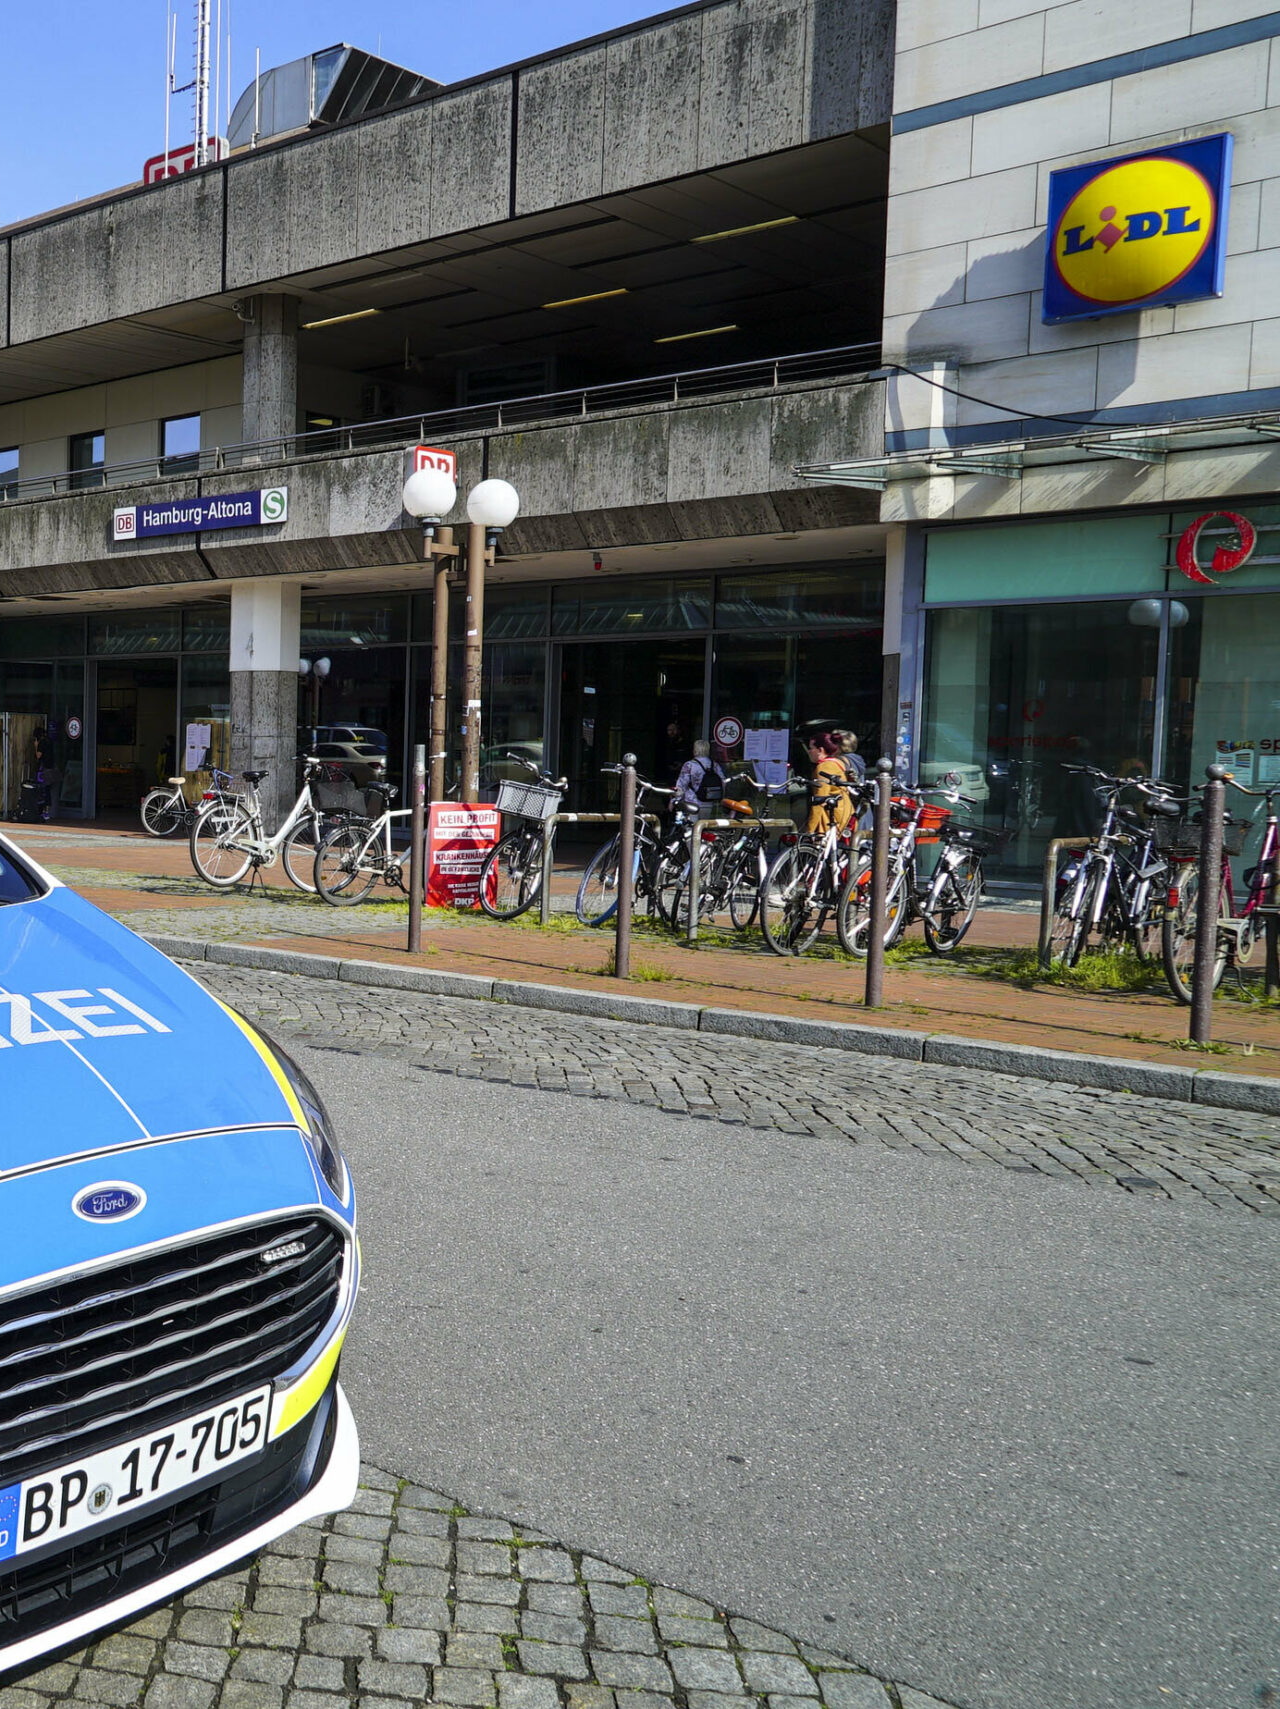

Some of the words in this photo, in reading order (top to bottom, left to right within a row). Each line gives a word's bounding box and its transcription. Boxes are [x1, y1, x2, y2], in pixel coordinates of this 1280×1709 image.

[117, 516, 133, 531] DB
[142, 500, 253, 527] Hamburg-Altona
[440, 814, 464, 825] KEIN
[467, 812, 496, 823] PROFIT
[435, 850, 489, 862] KRANKENHÄUS
[454, 897, 475, 906] DKP
[92, 1192, 128, 1213] Ford
[23, 1469, 88, 1542] BP
[117, 1394, 265, 1506] 17-705
